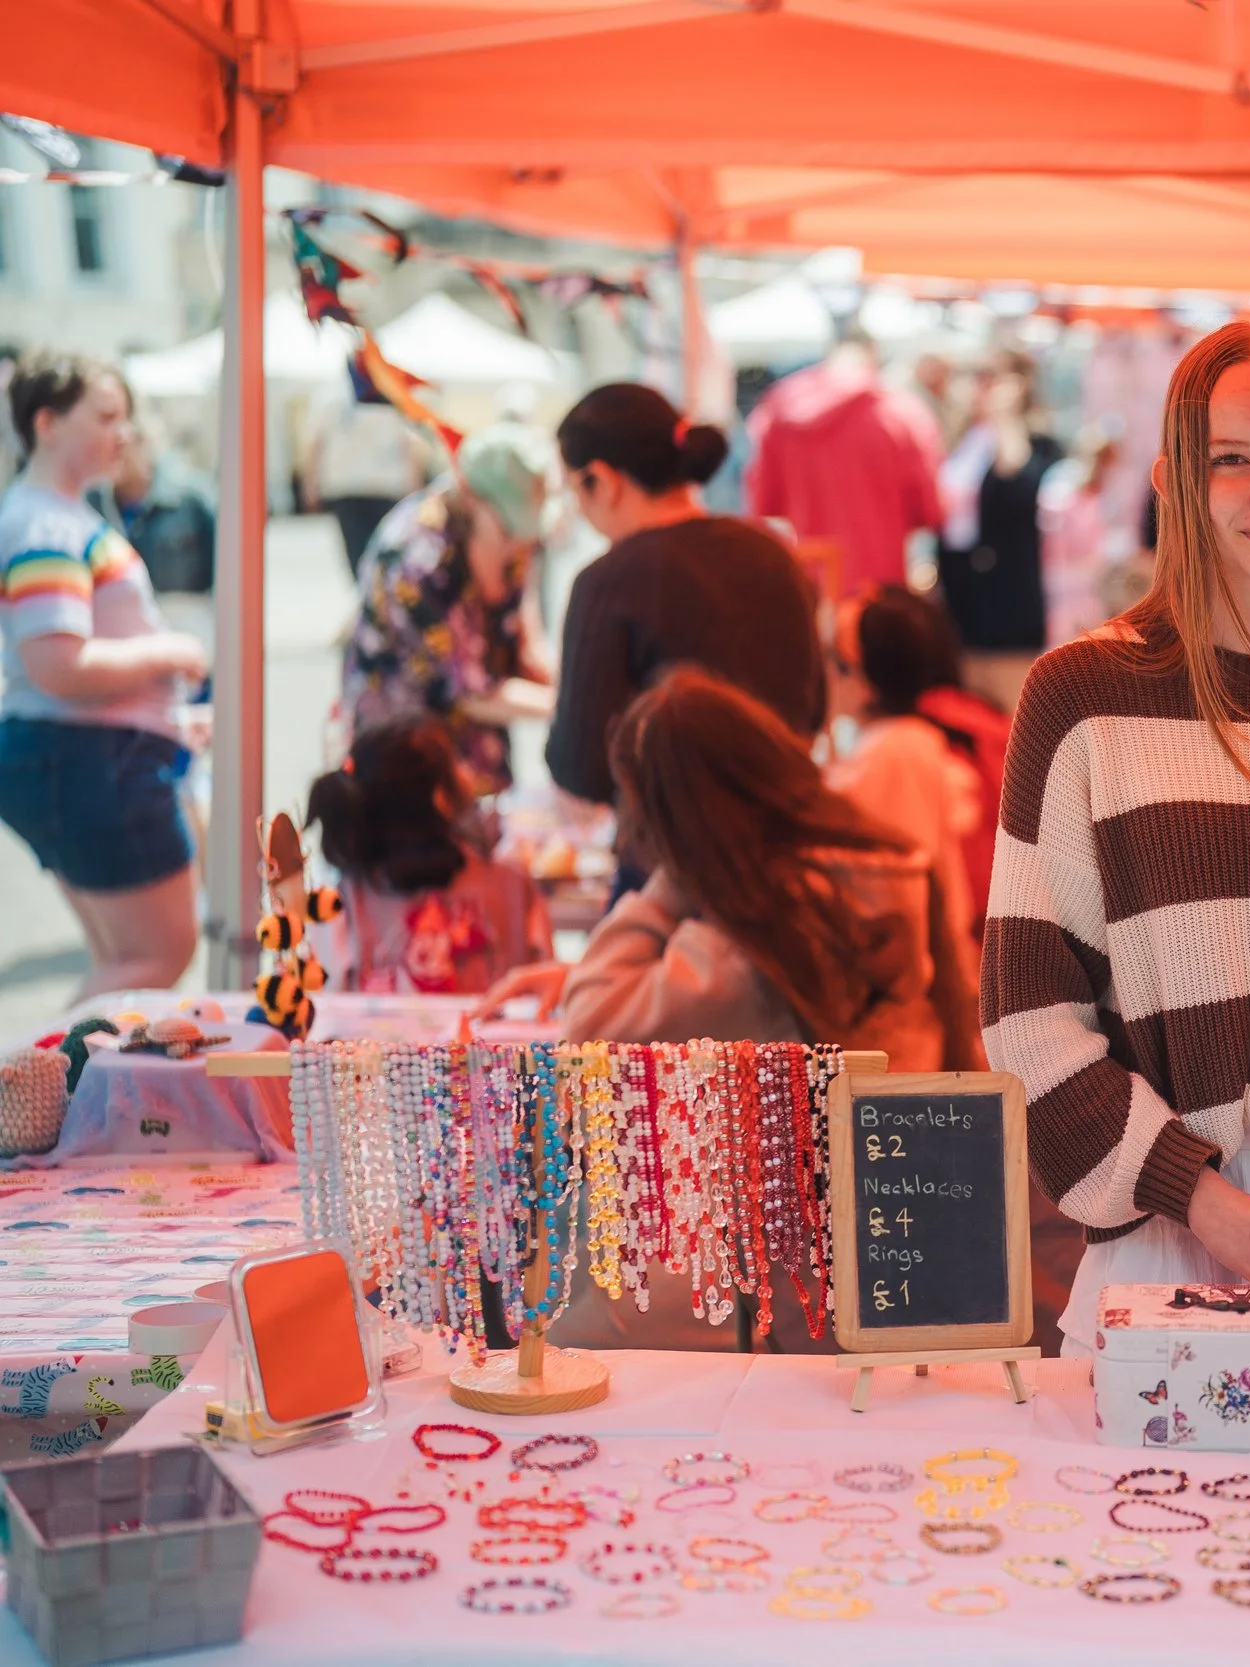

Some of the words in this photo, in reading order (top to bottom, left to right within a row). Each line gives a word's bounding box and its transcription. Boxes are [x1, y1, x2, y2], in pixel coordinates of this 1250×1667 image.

[860, 1104, 973, 1130] Bracelets
[864, 1174, 973, 1199] Necklaces
[868, 1244, 924, 1271] Rings
